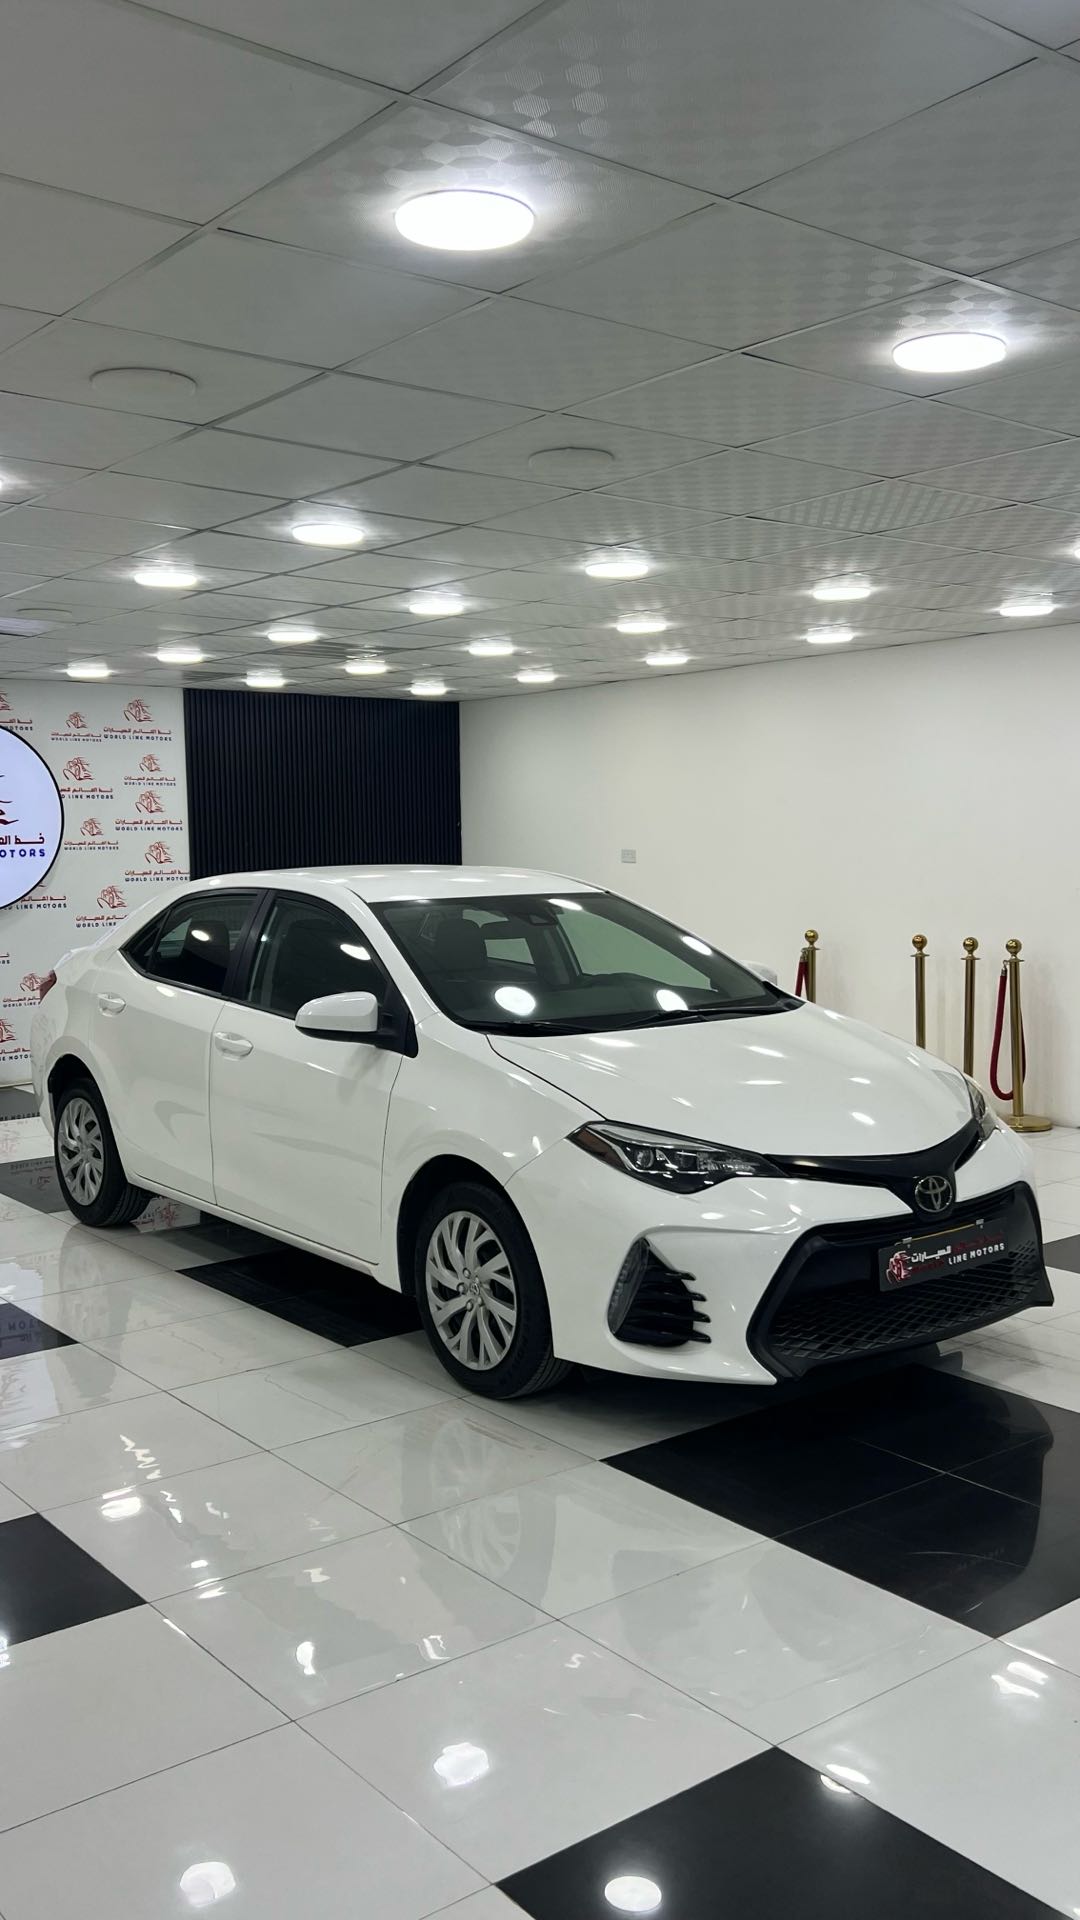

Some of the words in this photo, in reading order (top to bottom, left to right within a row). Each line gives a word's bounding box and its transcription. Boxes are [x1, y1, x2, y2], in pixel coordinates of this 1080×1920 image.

[14, 832, 45, 845] خط
[0, 848, 46, 858] OTORS
[948, 1252, 968, 1265] LINE
[969, 1242, 1005, 1259] MOTORS
